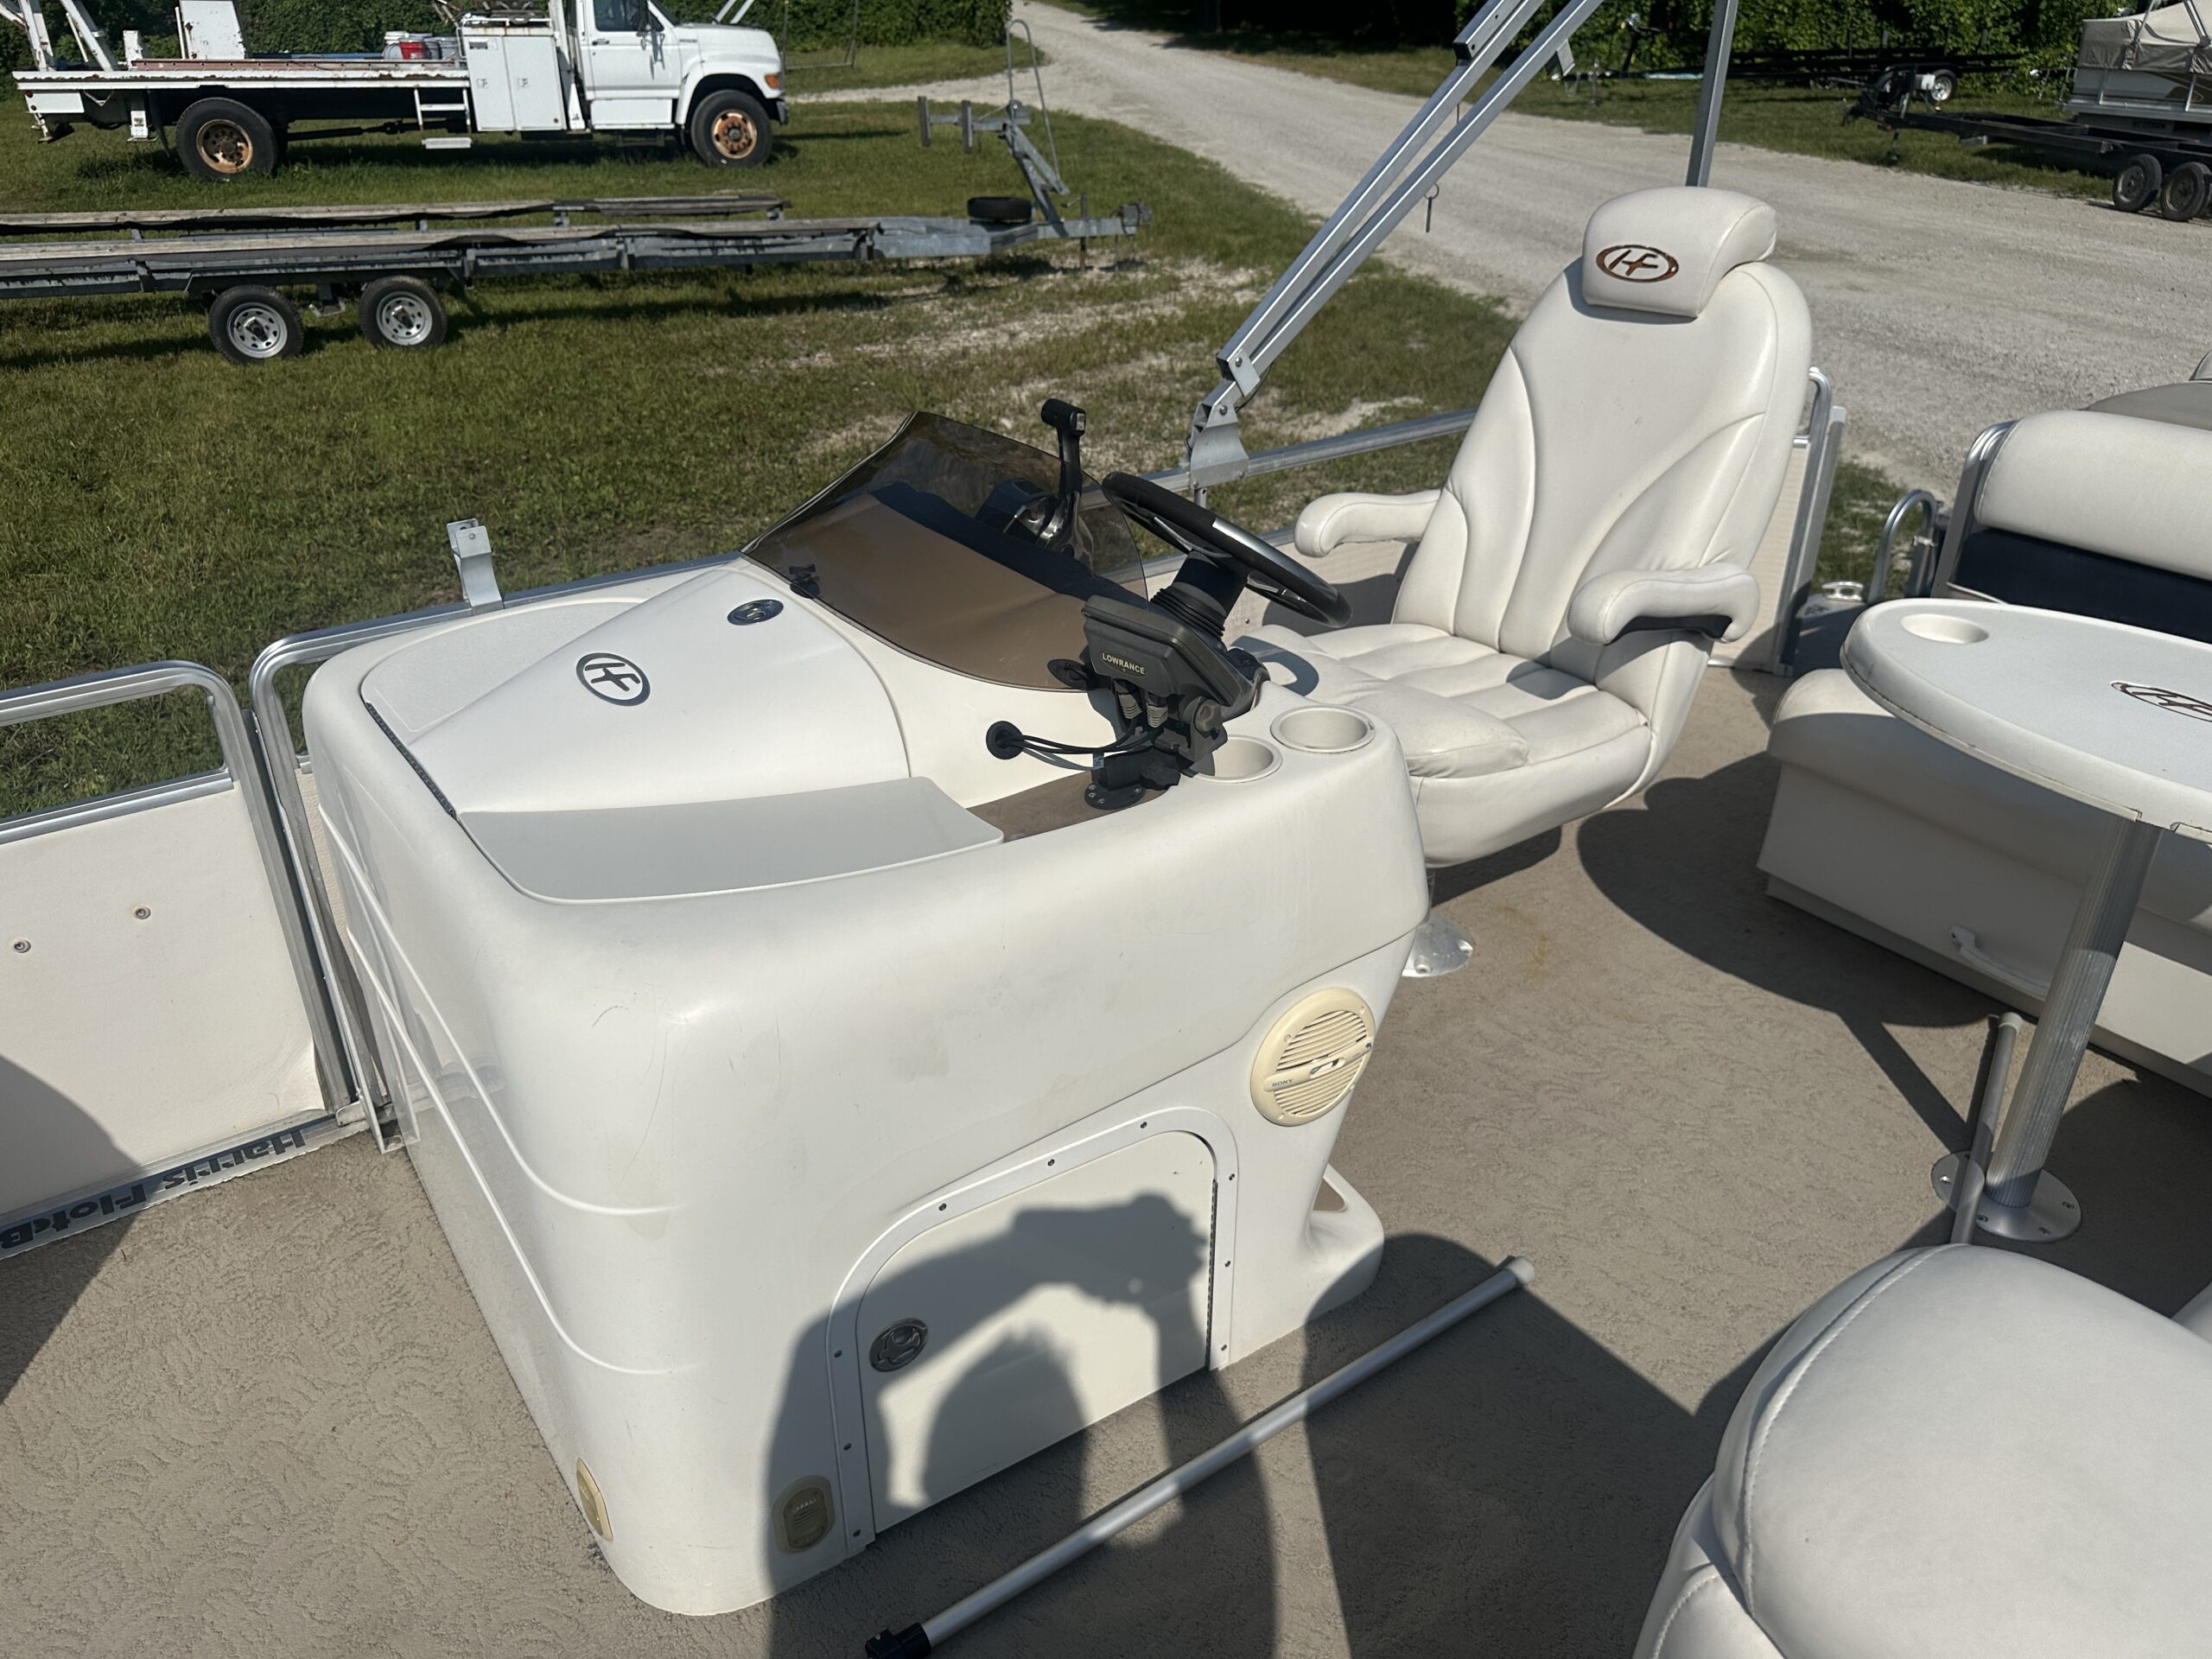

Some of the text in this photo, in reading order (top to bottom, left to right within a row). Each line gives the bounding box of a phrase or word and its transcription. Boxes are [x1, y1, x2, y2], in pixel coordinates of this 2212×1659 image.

[1102, 652, 1146, 675] LOWRANCE
[1272, 1078, 1294, 1087] SONY
[162, 1129, 307, 1190] Harris
